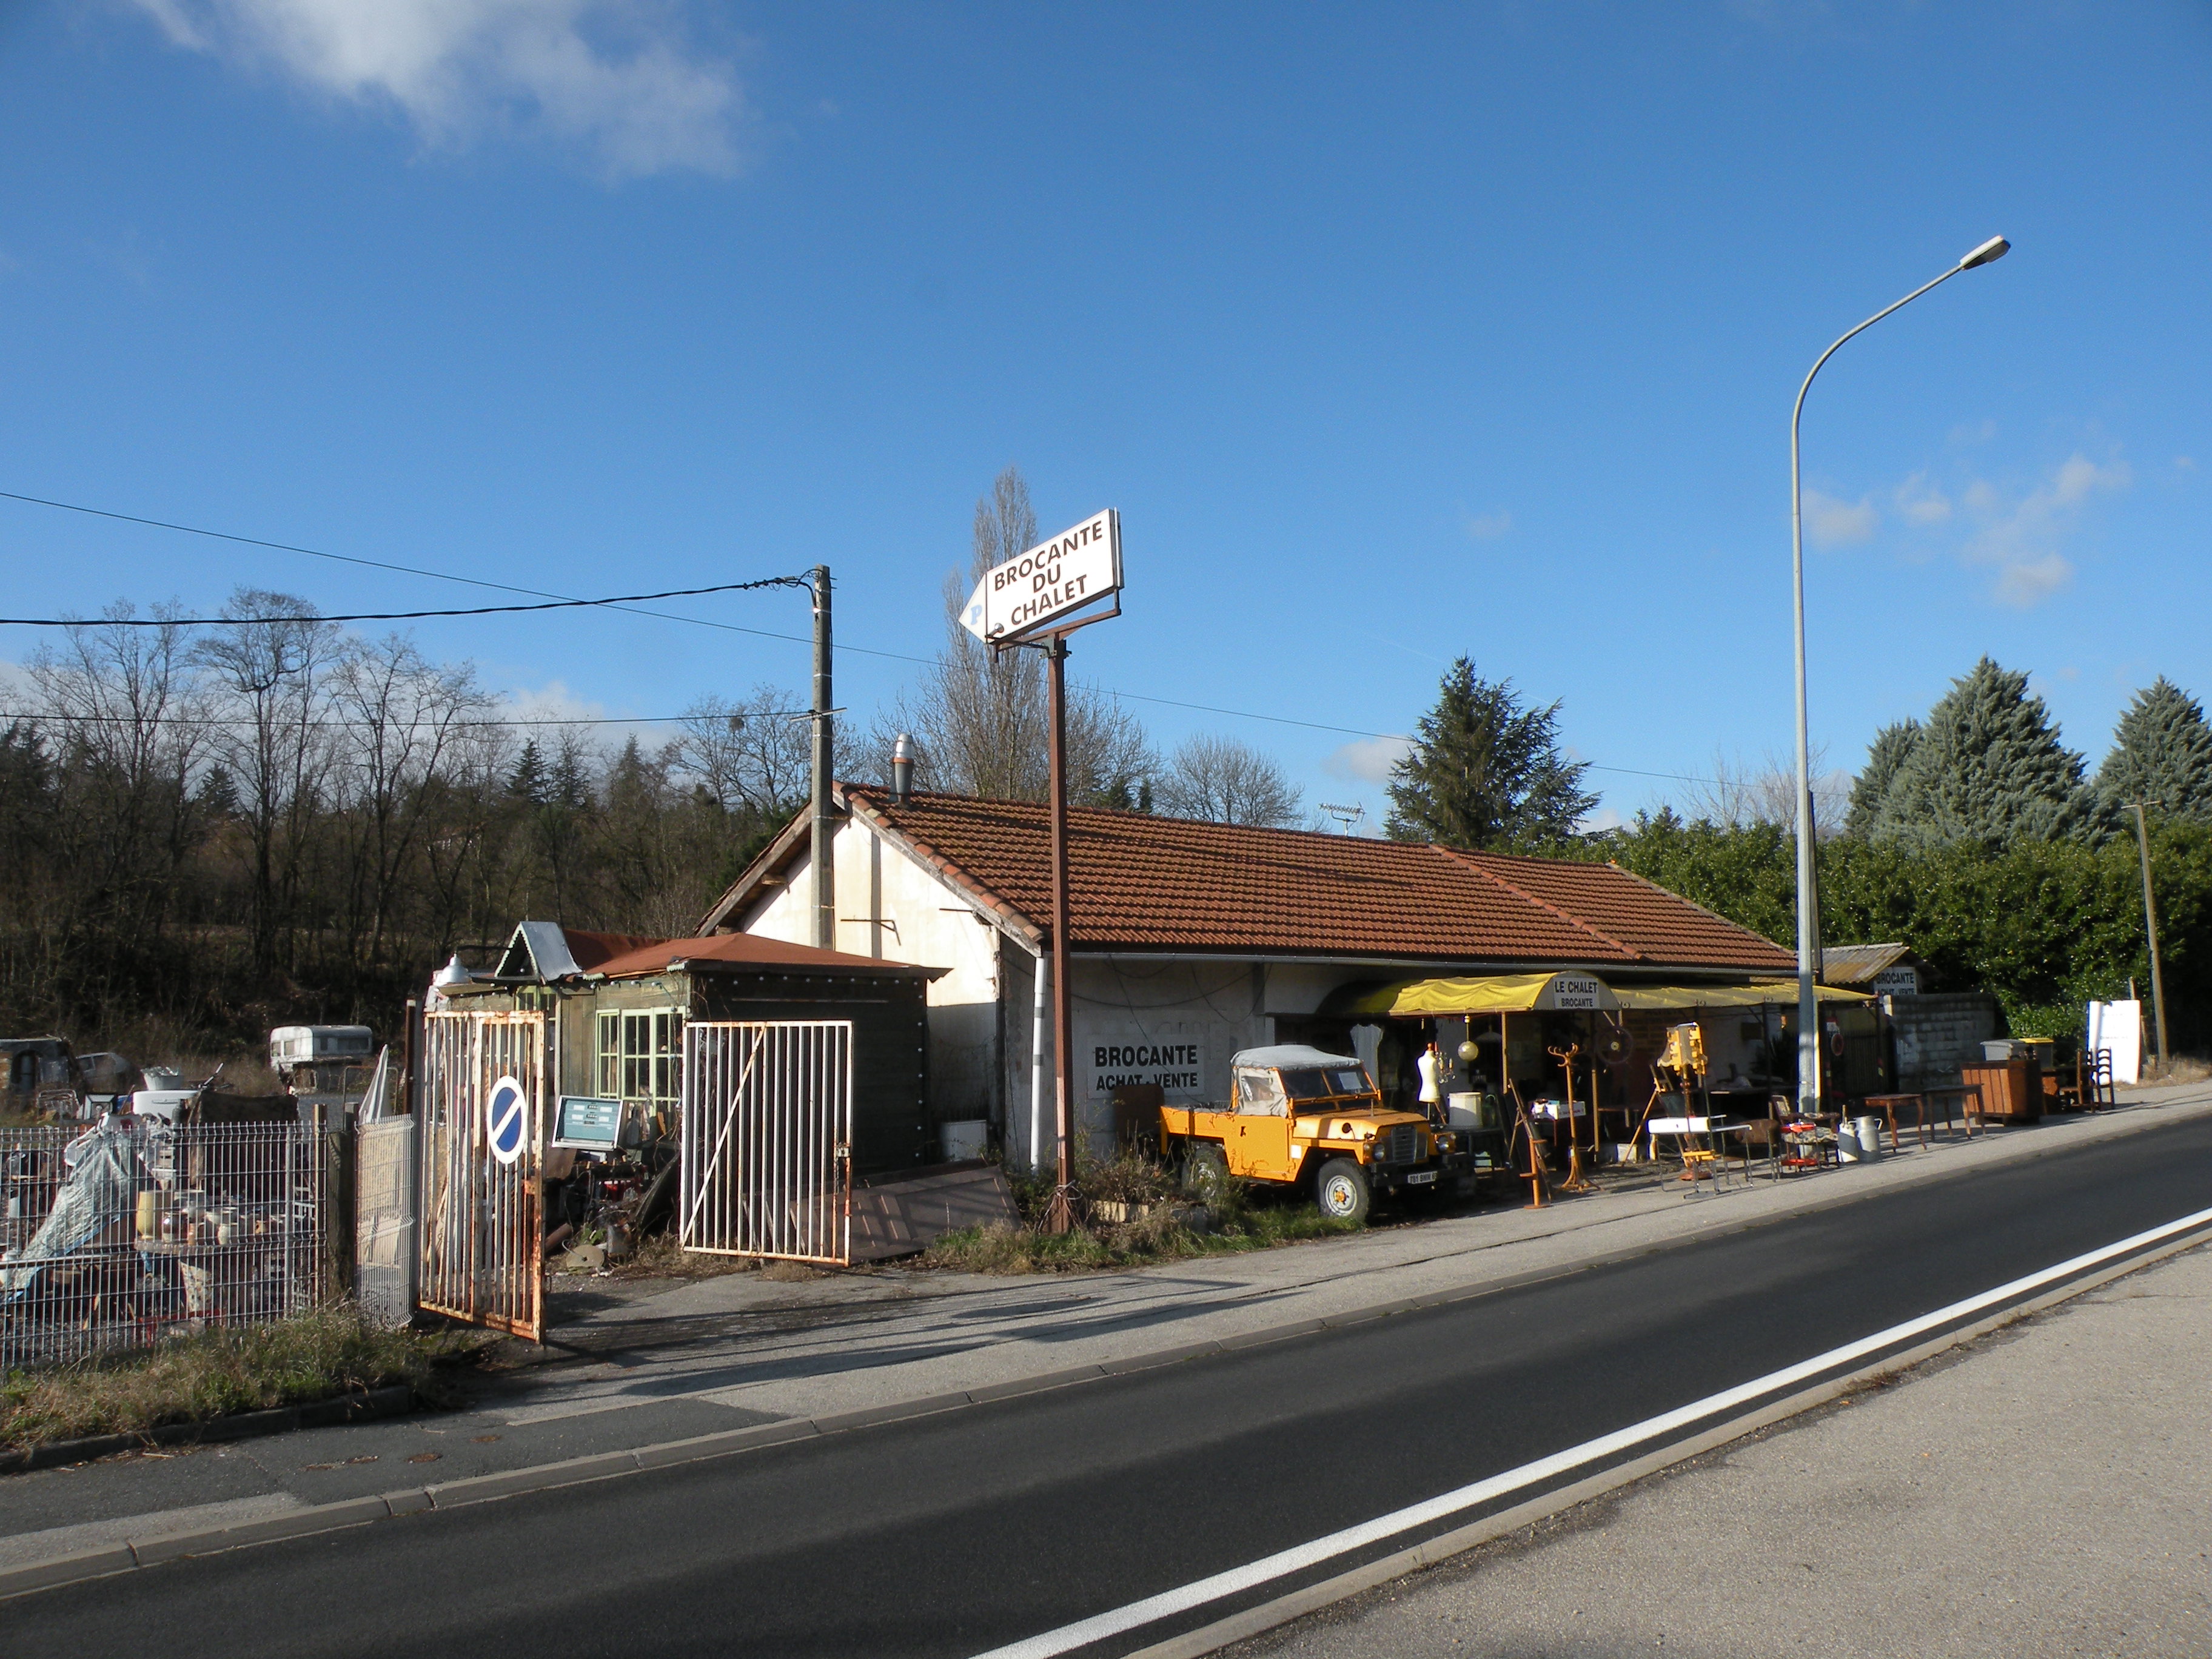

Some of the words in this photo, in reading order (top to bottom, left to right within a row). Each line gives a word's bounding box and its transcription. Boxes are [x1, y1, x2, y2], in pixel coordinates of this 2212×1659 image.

[994, 520, 1102, 591] BROCANTE
[1033, 564, 1061, 593] DU
[1011, 574, 1087, 625] CHALET
[971, 605, 982, 625] P
[1555, 981, 1564, 993] LE
[1567, 982, 1598, 993] CHALET
[1561, 998, 1593, 1007] BROCANTE
[1095, 1045, 1198, 1067] BROCANTE
[1154, 1073, 1198, 1088] VENTE
